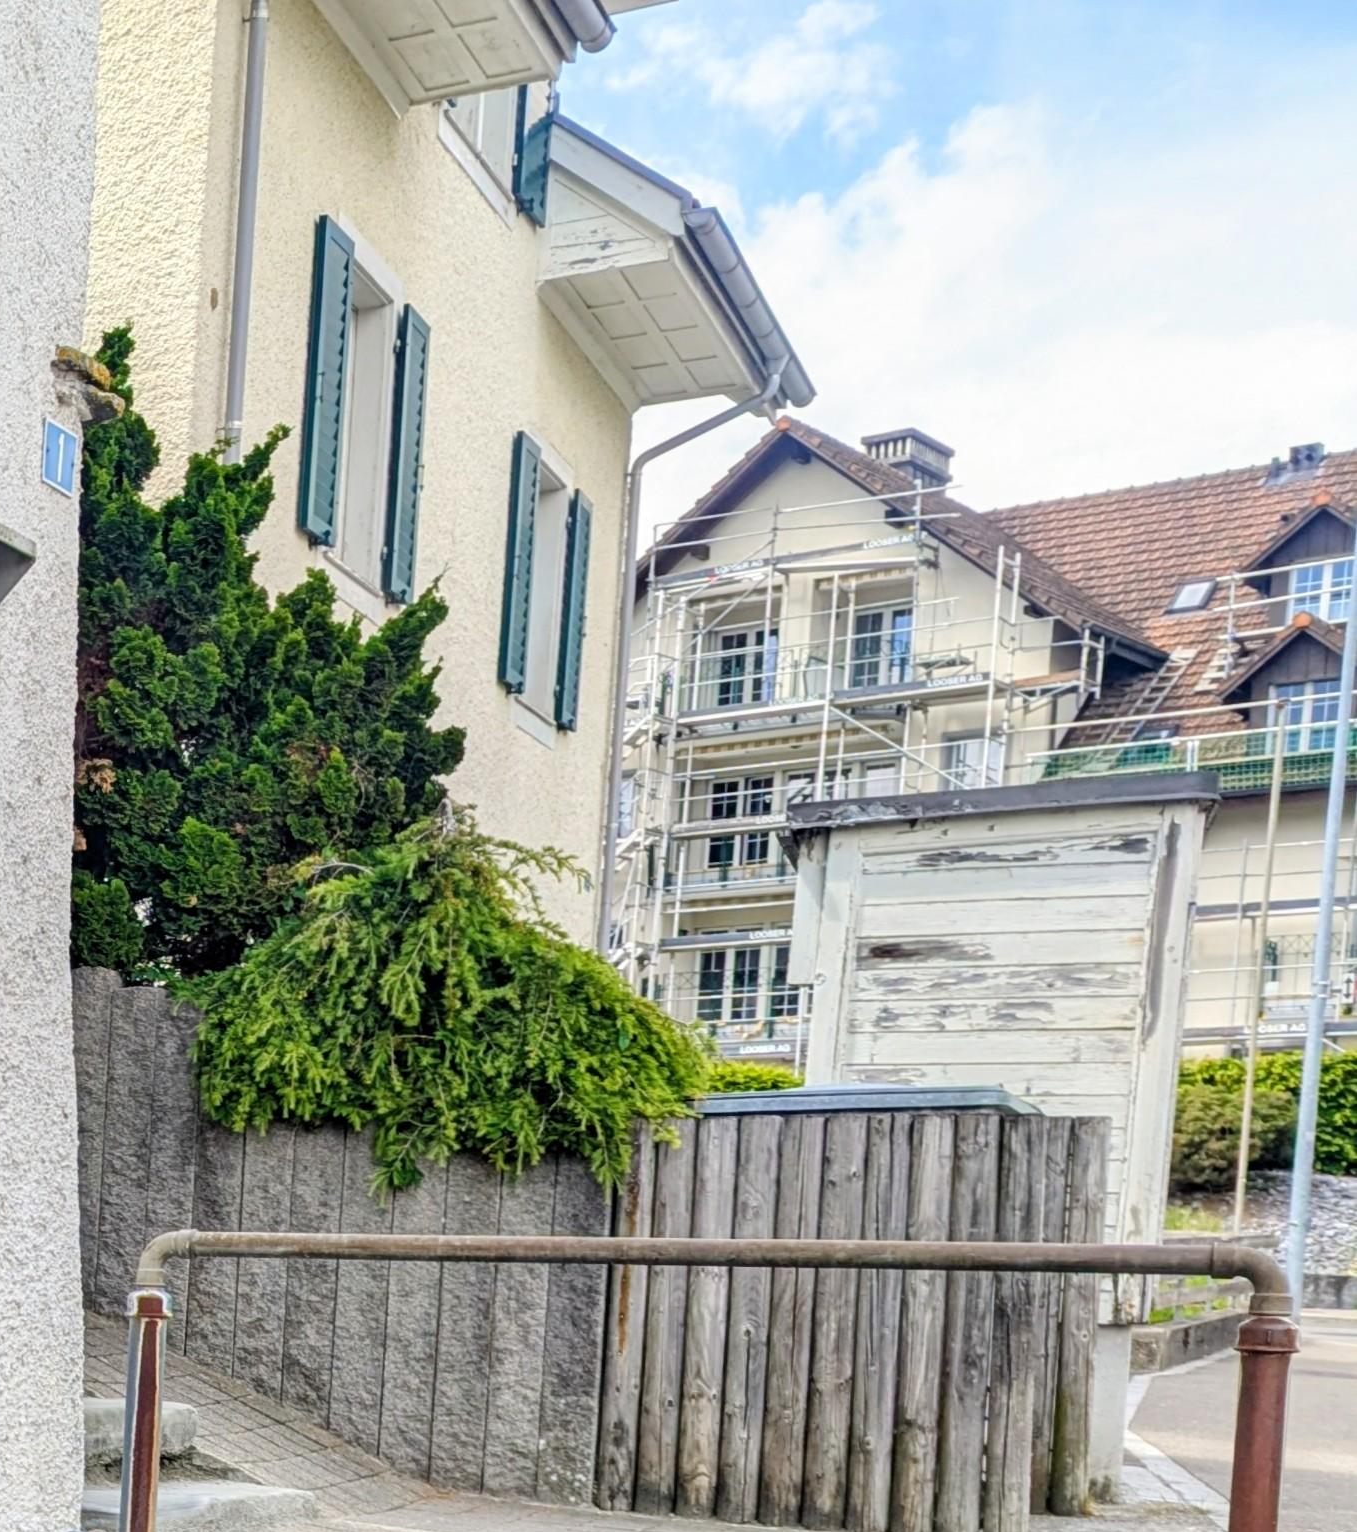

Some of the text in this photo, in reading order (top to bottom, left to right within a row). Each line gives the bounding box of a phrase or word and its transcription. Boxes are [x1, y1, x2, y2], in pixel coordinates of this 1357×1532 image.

[927, 673, 984, 688] LOOSER AG
[1243, 1023, 1288, 1034] LOSER
